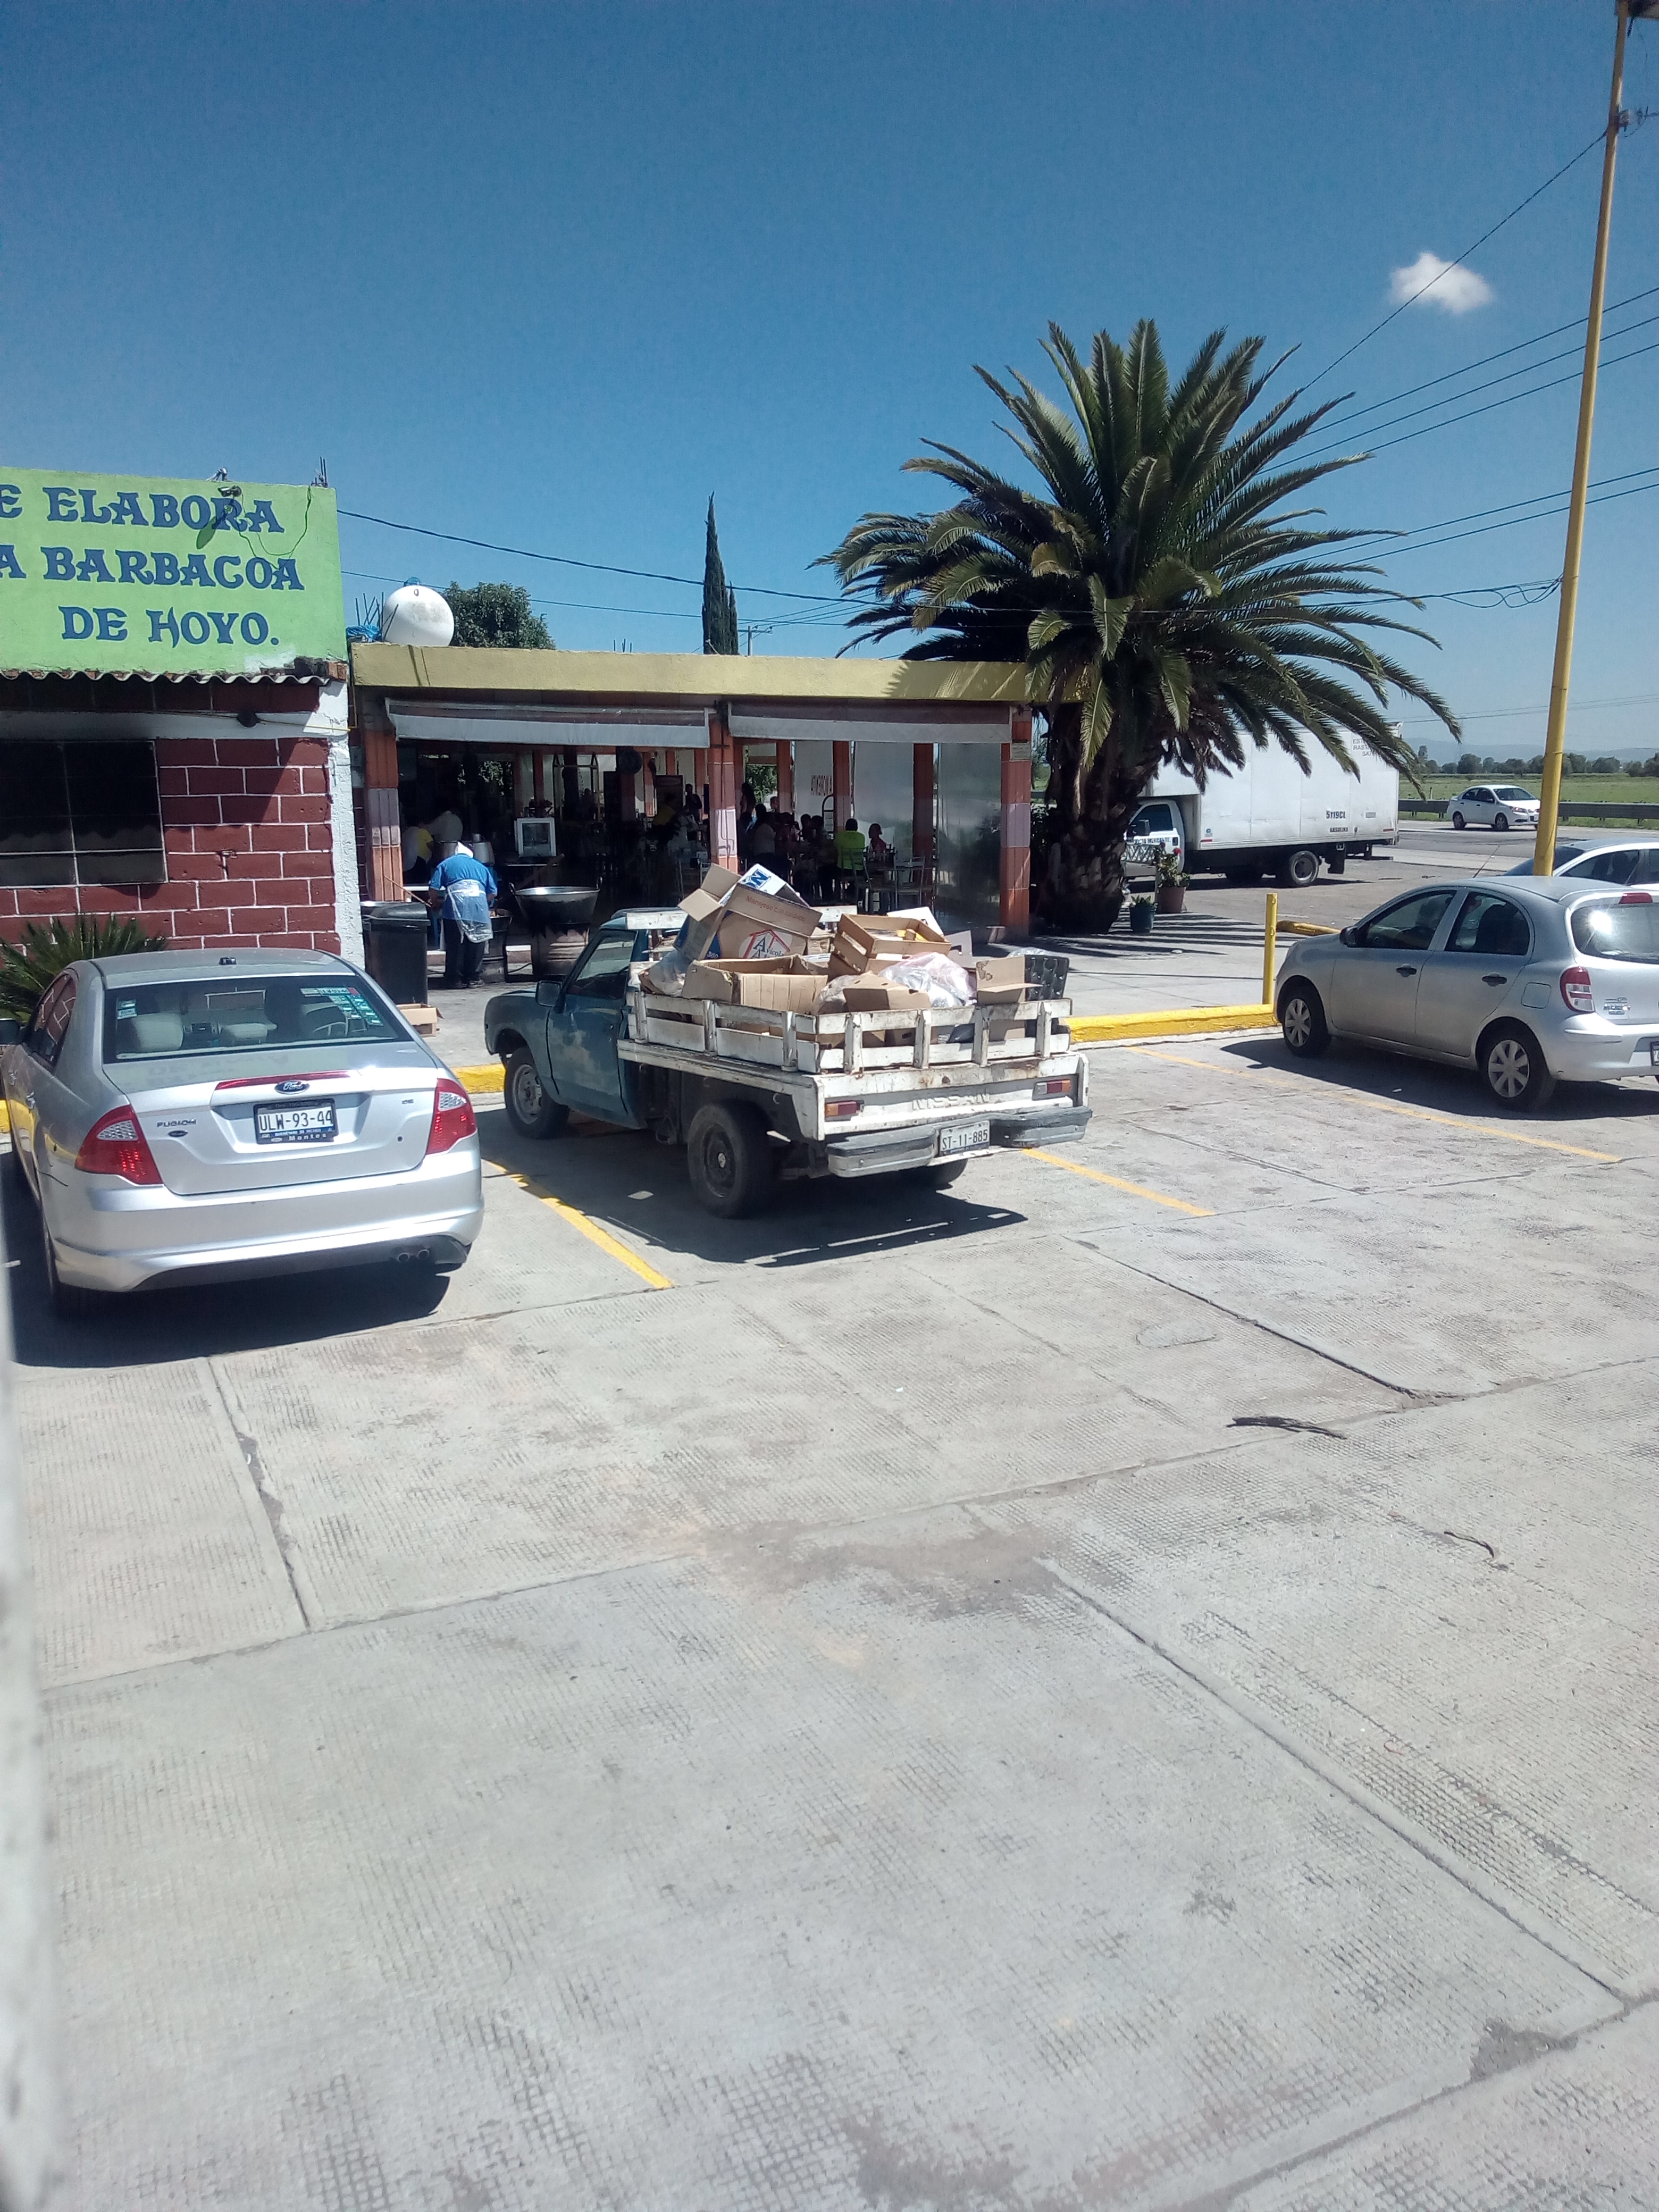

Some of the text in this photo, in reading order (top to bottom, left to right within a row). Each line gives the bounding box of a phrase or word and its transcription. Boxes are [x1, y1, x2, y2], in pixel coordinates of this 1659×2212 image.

[43, 487, 284, 533] ELABORA
[0, 545, 305, 590] A BARBACOA
[58, 606, 279, 648] DE HOYO.
[283, 1081, 306, 1090] Ford
[912, 1093, 990, 1110] NISSAN
[259, 1110, 333, 1131] ULW-93-44
[942, 1129, 988, 1150] ST-11-885
